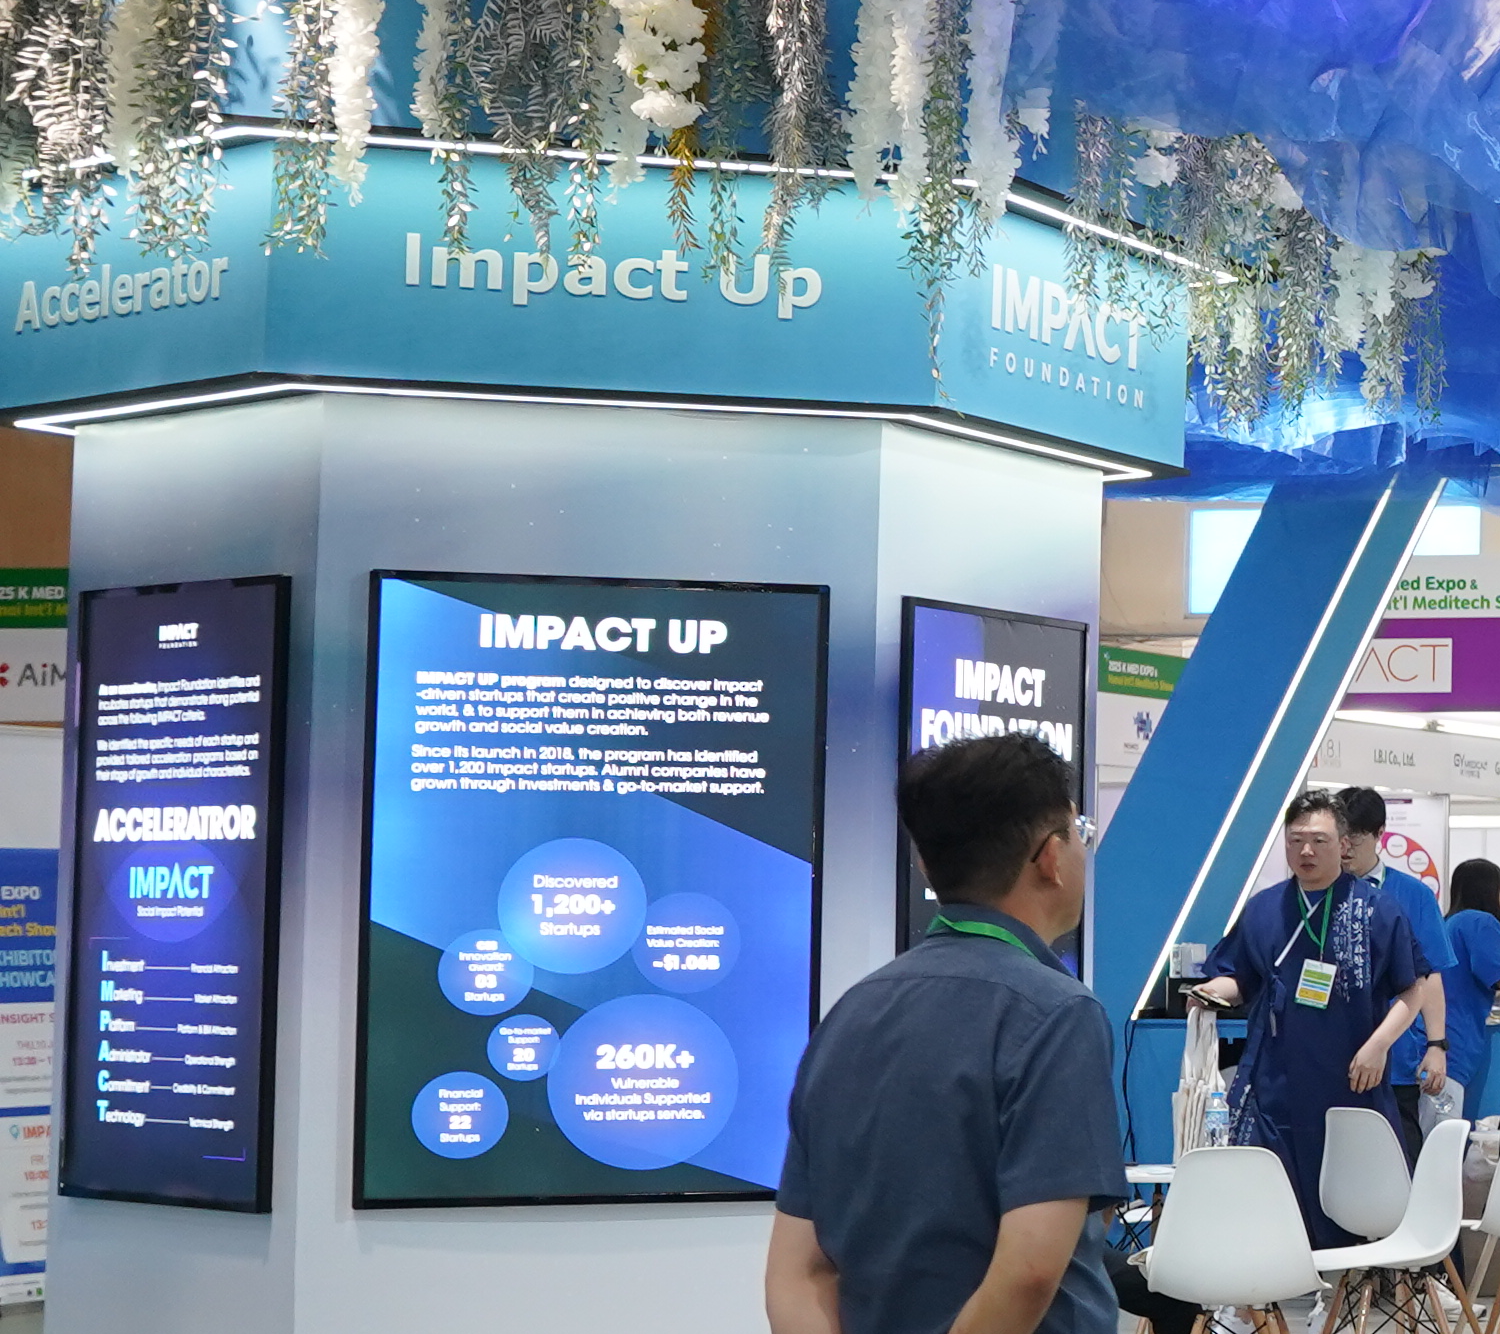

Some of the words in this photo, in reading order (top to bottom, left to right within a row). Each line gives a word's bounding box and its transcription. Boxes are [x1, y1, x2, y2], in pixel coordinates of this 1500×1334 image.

[405, 230, 688, 309] Impact
[717, 251, 823, 322] Up
[14, 256, 229, 334] Accelerator
[990, 262, 1145, 373] IMPACT
[989, 347, 1146, 409] FOUNDATION
[1425, 576, 1467, 593] Expo
[1412, 595, 1491, 610] Meditech
[478, 612, 657, 653] IMPACT
[667, 619, 728, 655] UP
[478, 671, 499, 686] UP
[500, 673, 566, 692] program
[569, 674, 634, 693] designed
[654, 676, 711, 692] discover
[955, 658, 1046, 708] IMPACT
[93, 804, 256, 843] ACCELERATROR
[129, 862, 214, 900] IMPACT
[532, 874, 618, 889] Discovered
[530, 893, 617, 918] 1,200+
[539, 921, 601, 938] Startups
[595, 1043, 695, 1070] 260K+
[610, 1077, 680, 1090] Vulnerable
[574, 1092, 641, 1107] Individuals
[643, 1092, 711, 1107] Supported
[583, 1108, 604, 1121] via
[605, 1108, 655, 1122] startups
[656, 1107, 706, 1121] service.
